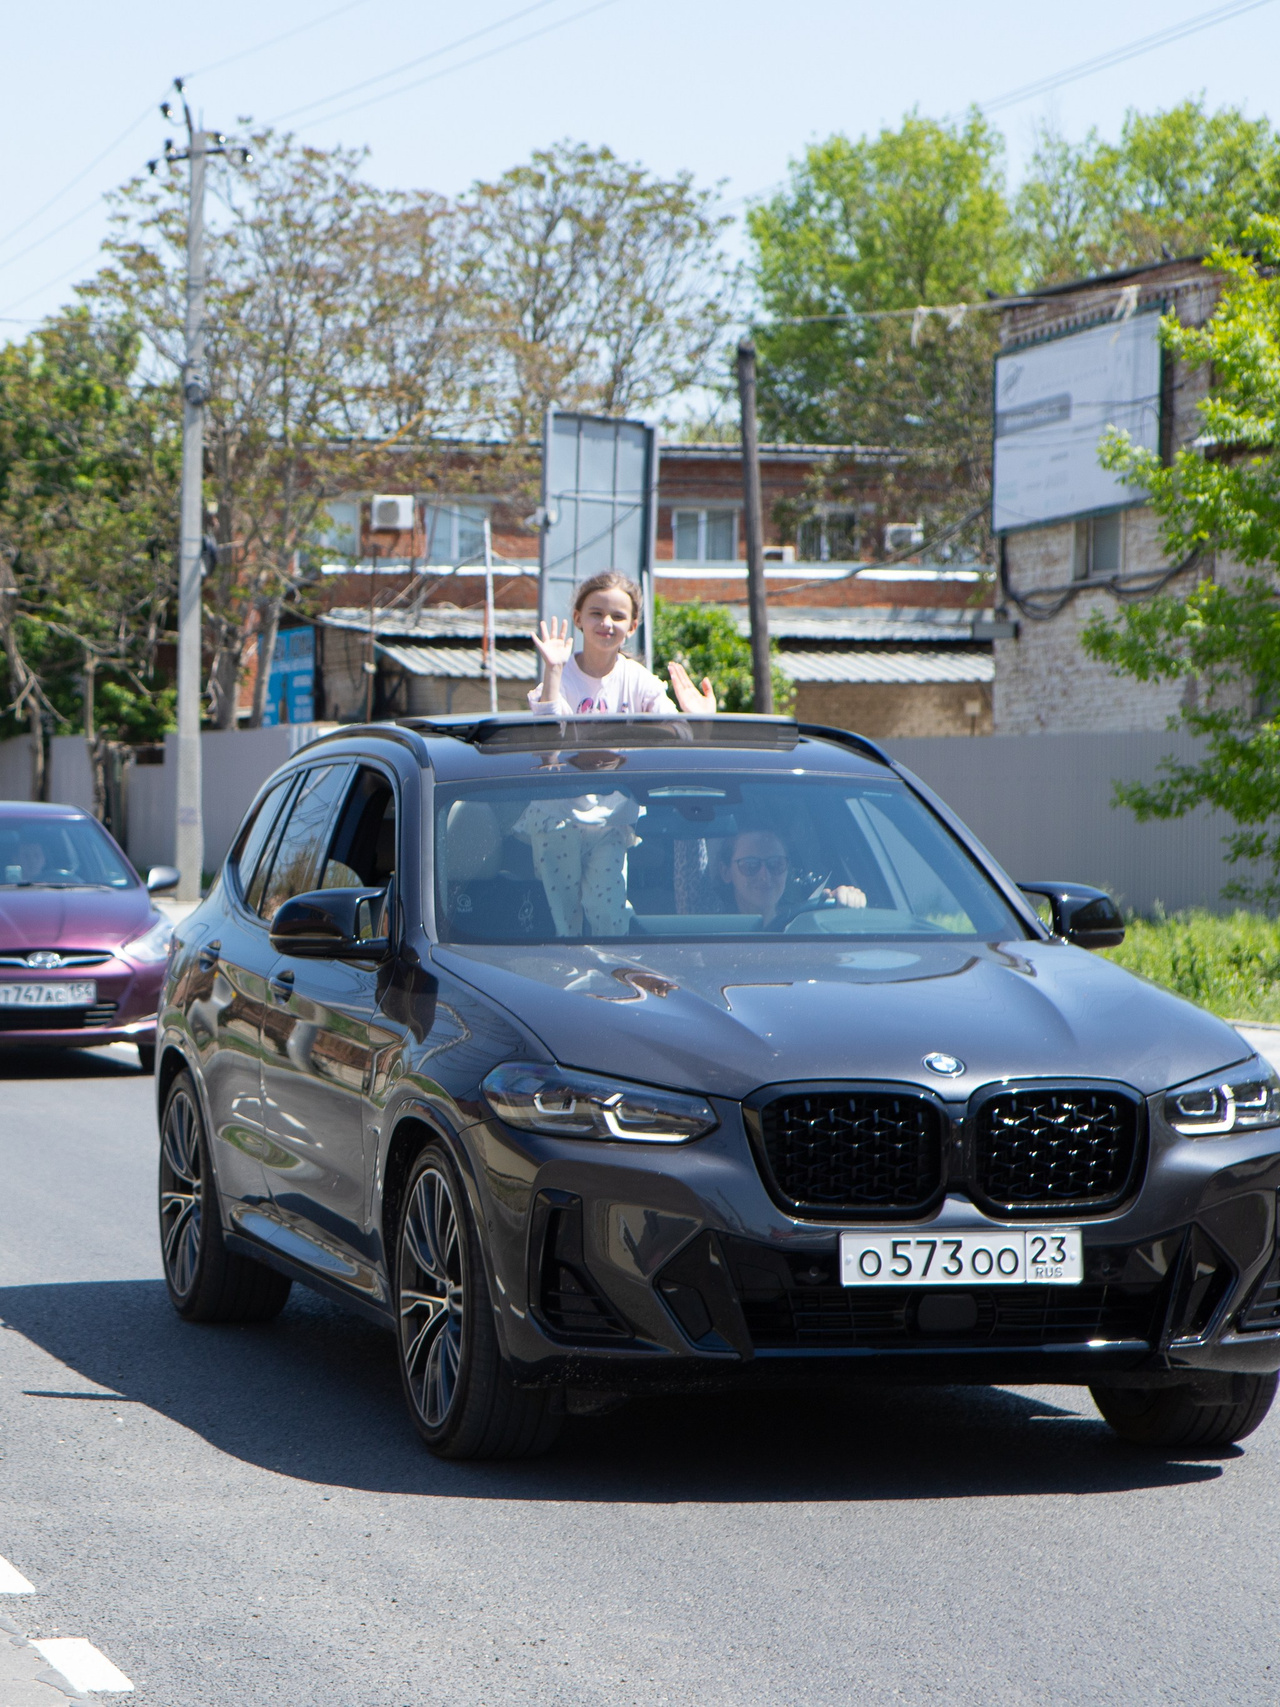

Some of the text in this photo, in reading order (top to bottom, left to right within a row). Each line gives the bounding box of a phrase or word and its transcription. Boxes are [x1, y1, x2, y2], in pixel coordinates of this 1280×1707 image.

[858, 1235, 1067, 1277] O573OO 23
[1035, 1266, 1064, 1279] RUS
